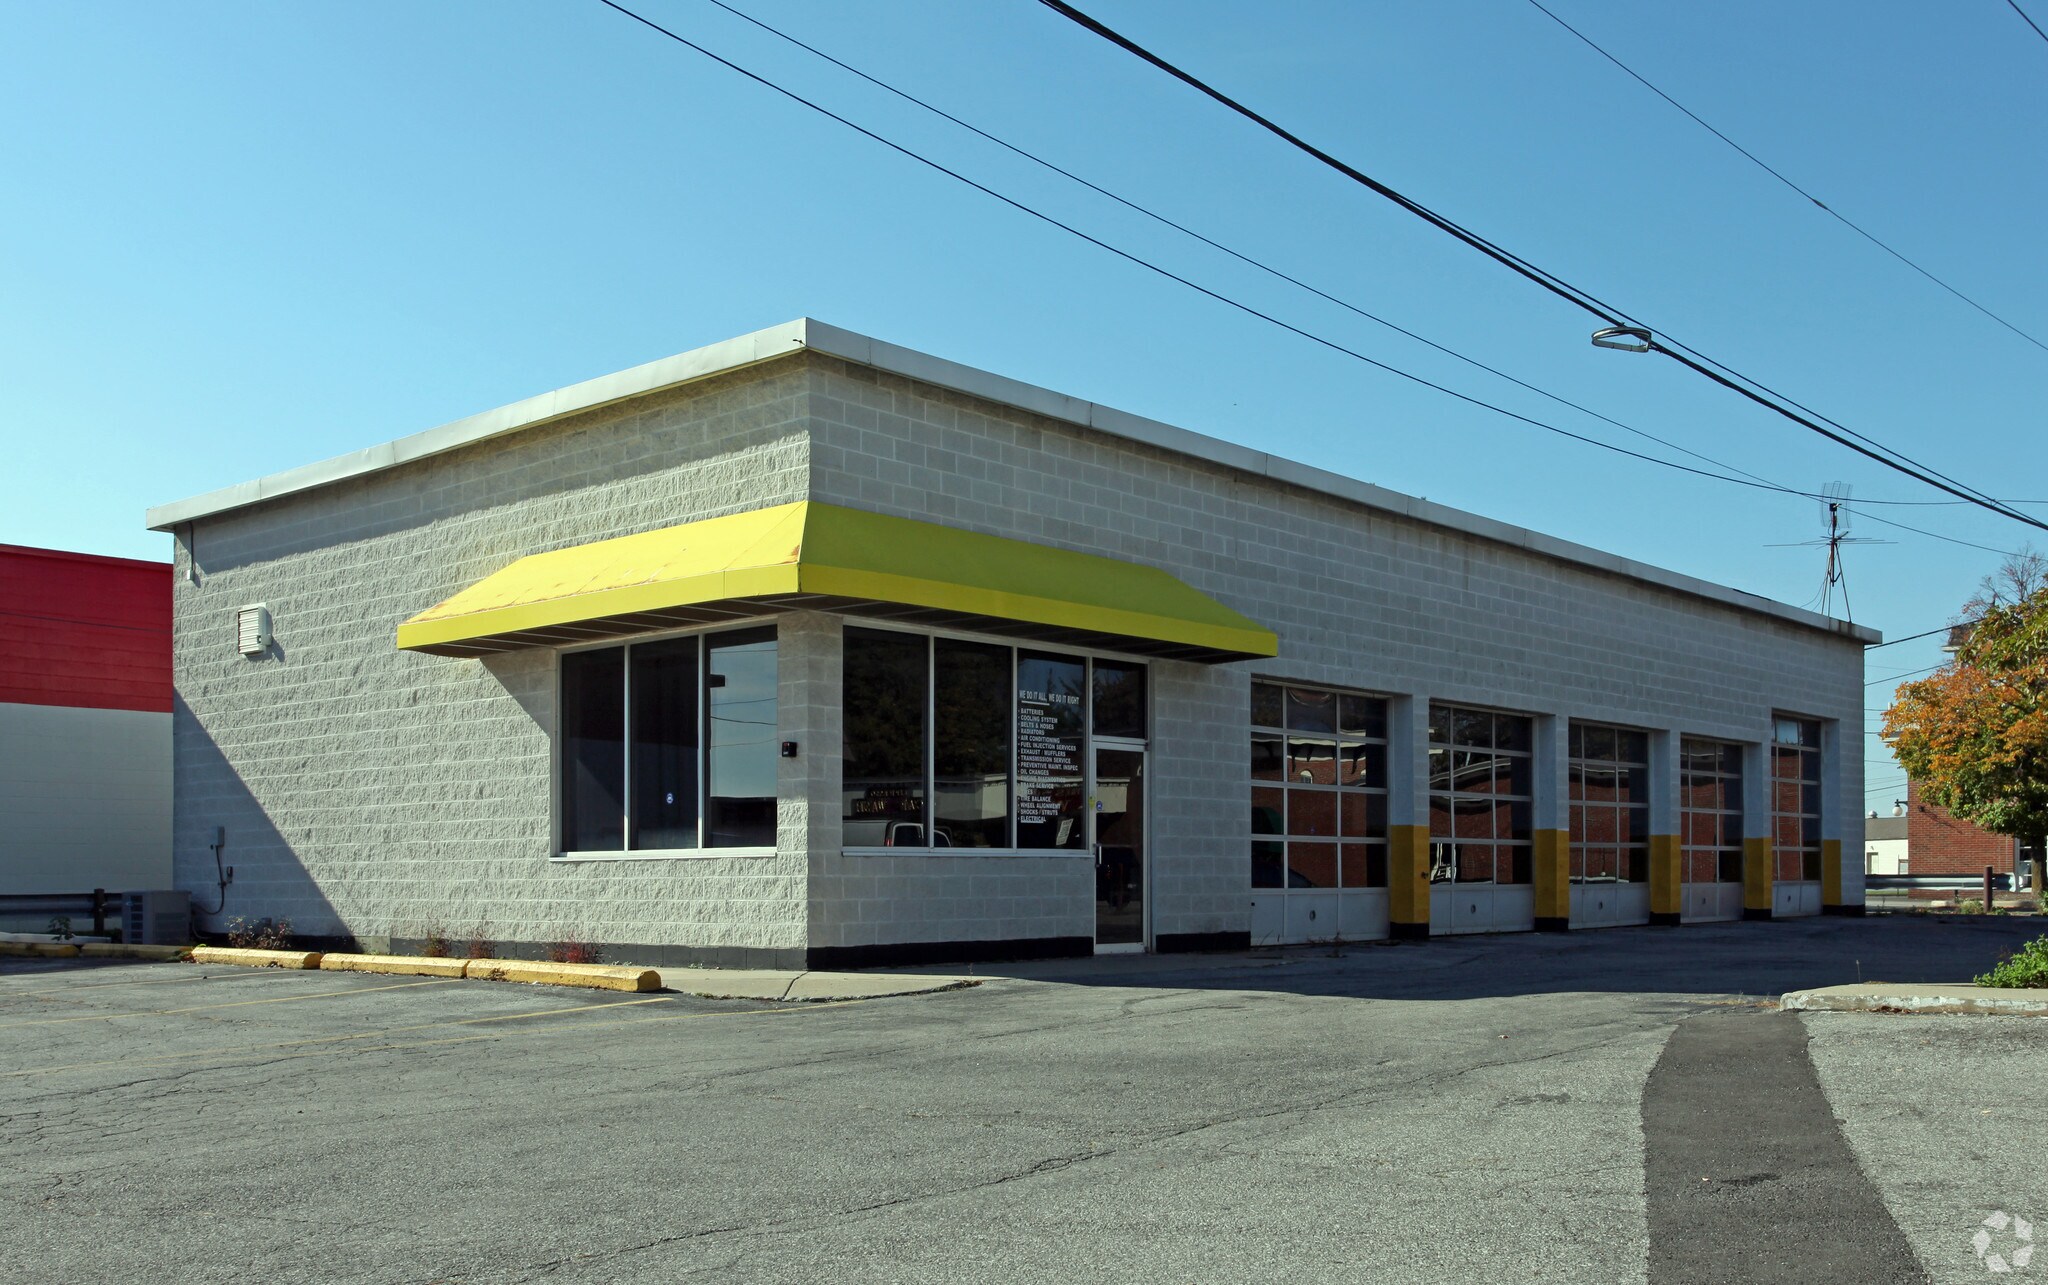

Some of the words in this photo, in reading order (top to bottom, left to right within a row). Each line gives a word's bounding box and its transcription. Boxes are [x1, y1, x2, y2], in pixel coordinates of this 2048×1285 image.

[1019, 690, 1025, 698] WE
[1027, 691, 1032, 699] DO
[1049, 693, 1054, 701] WE
[1068, 696, 1079, 704] RIGHT
